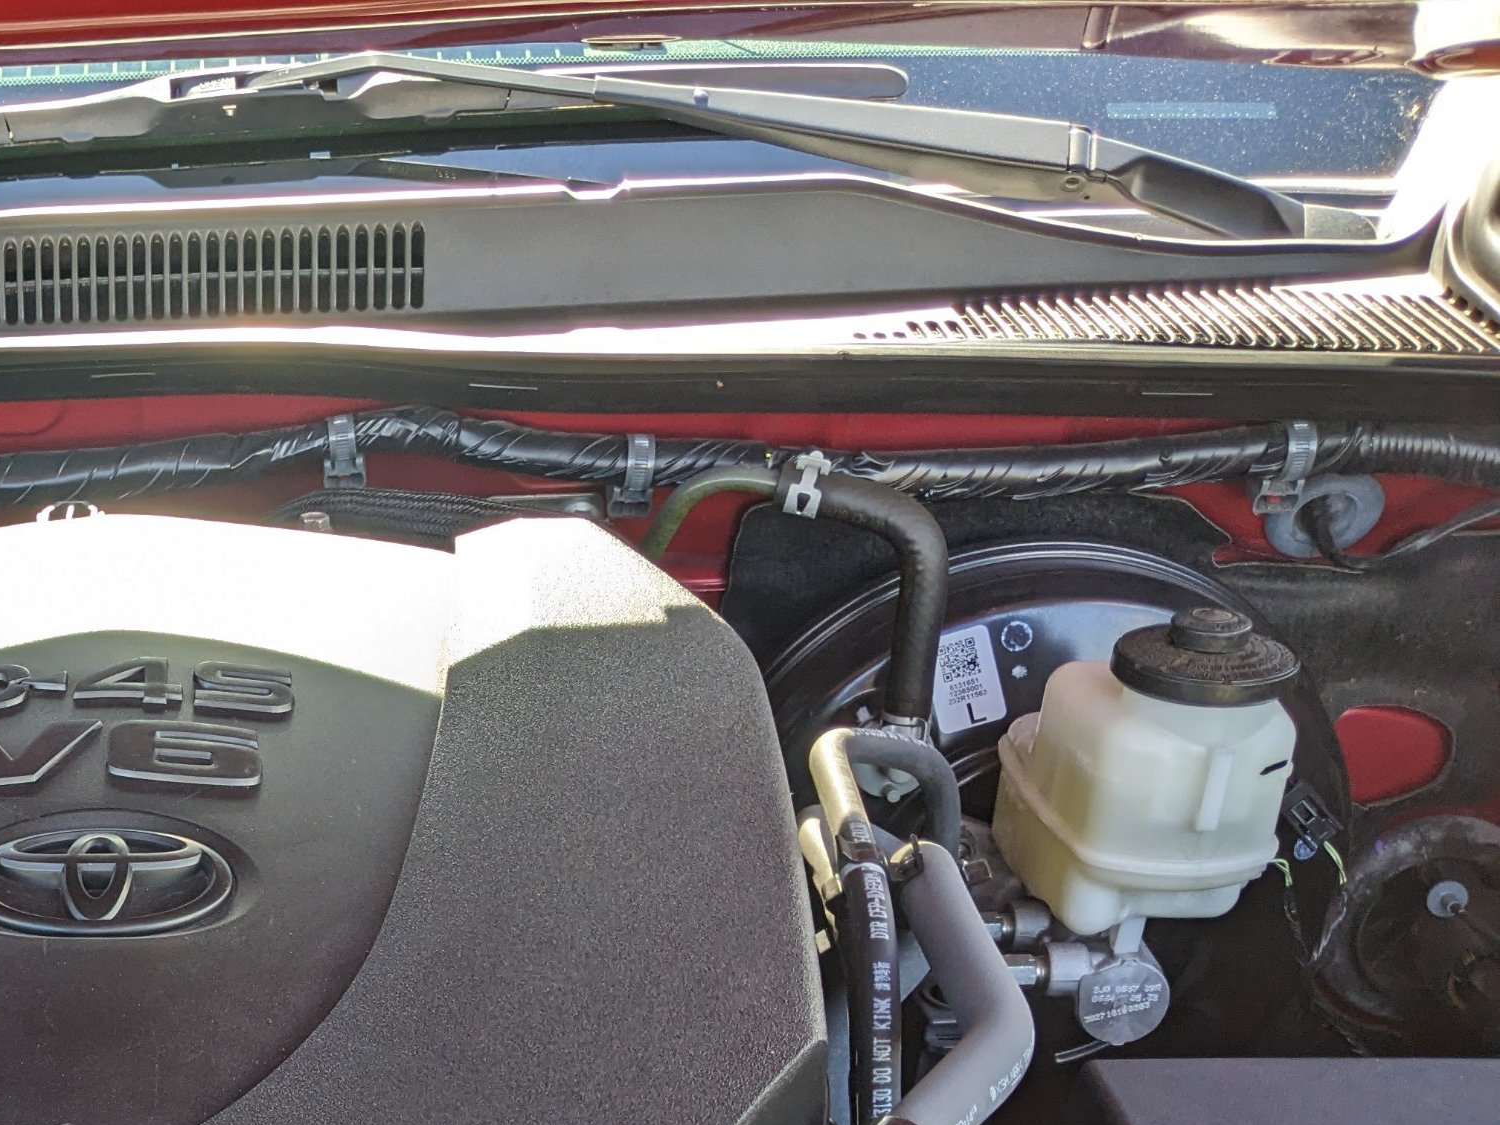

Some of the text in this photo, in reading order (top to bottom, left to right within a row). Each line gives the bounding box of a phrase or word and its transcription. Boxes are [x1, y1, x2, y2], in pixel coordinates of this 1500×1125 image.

[966, 703, 987, 724] L
[873, 998, 891, 1030] KINK
[873, 1037, 891, 1062] NOT
